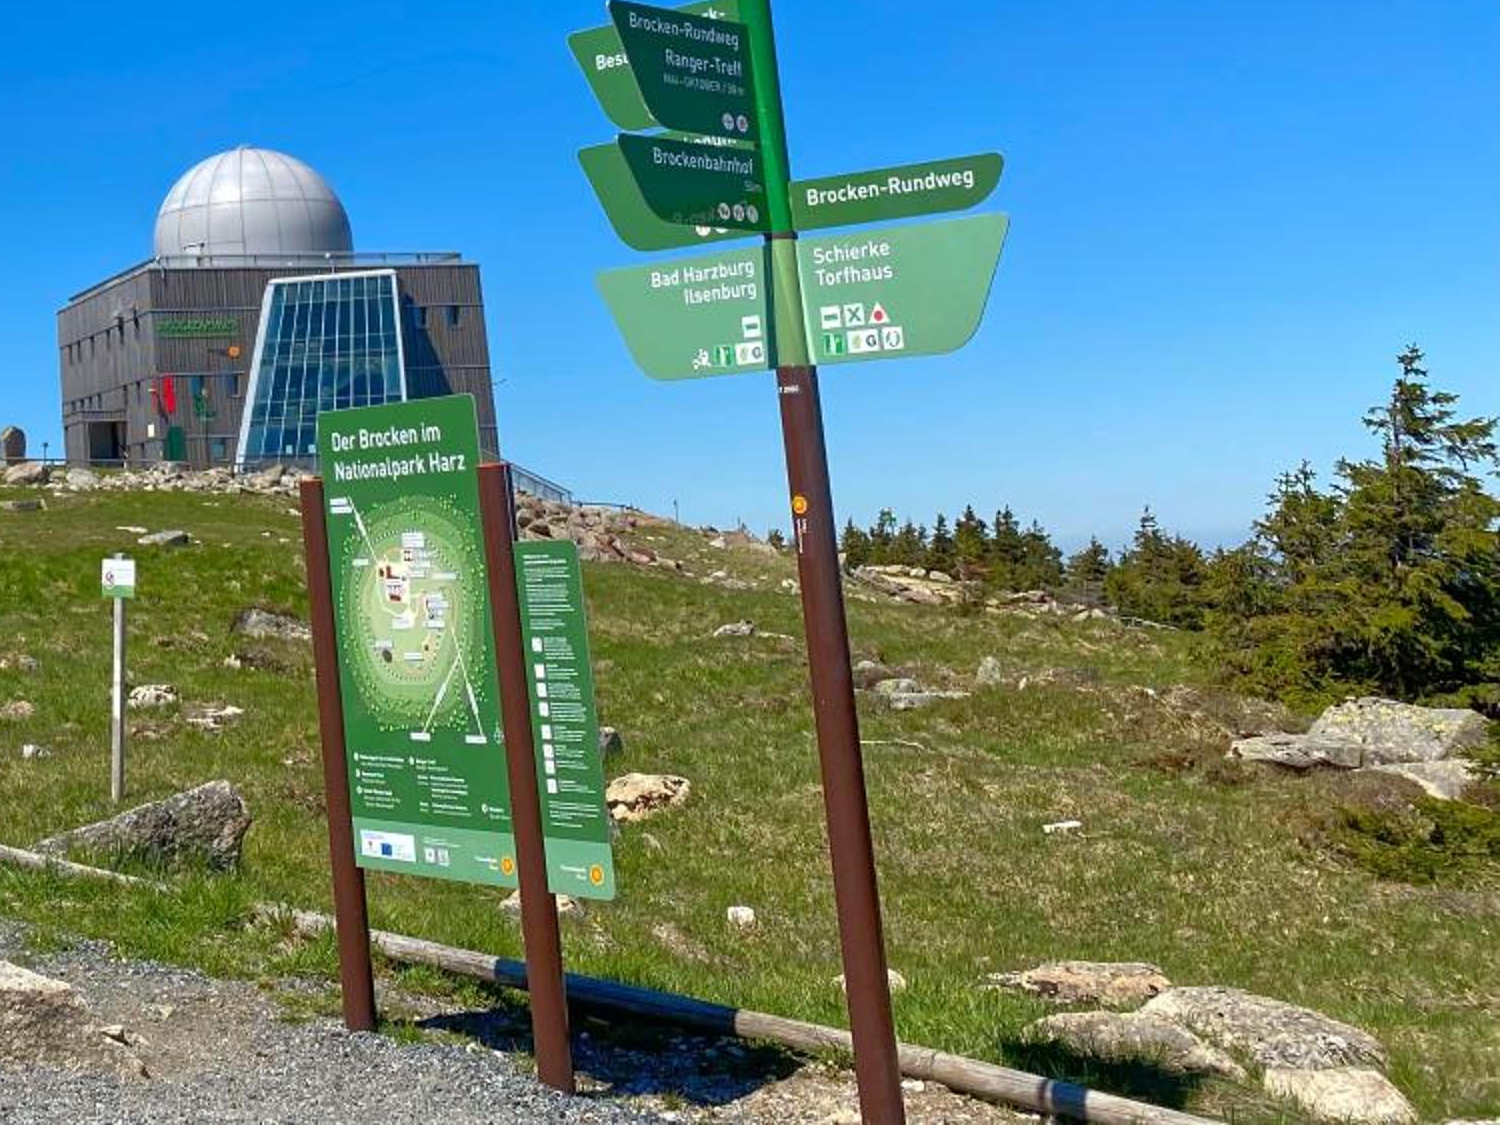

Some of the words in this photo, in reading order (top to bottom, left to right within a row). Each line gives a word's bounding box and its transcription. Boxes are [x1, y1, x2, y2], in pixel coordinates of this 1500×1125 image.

[628, 12, 739, 51] Brocken-Rundweg
[665, 48, 742, 77] Ranger-Treff
[653, 147, 753, 175] Brockenbahnhof
[806, 170, 975, 206] Brocken-Rundweg
[813, 241, 891, 265] Schierke
[651, 269, 679, 288] Bad
[683, 261, 755, 284] Harzburg
[816, 264, 894, 286] Torfhaus
[684, 283, 757, 306] Ilsenburg
[331, 432, 357, 452] Der
[359, 426, 418, 449] Brocken
[421, 422, 441, 442] im
[334, 454, 427, 482] Nationalpark
[428, 451, 466, 473] Harz
